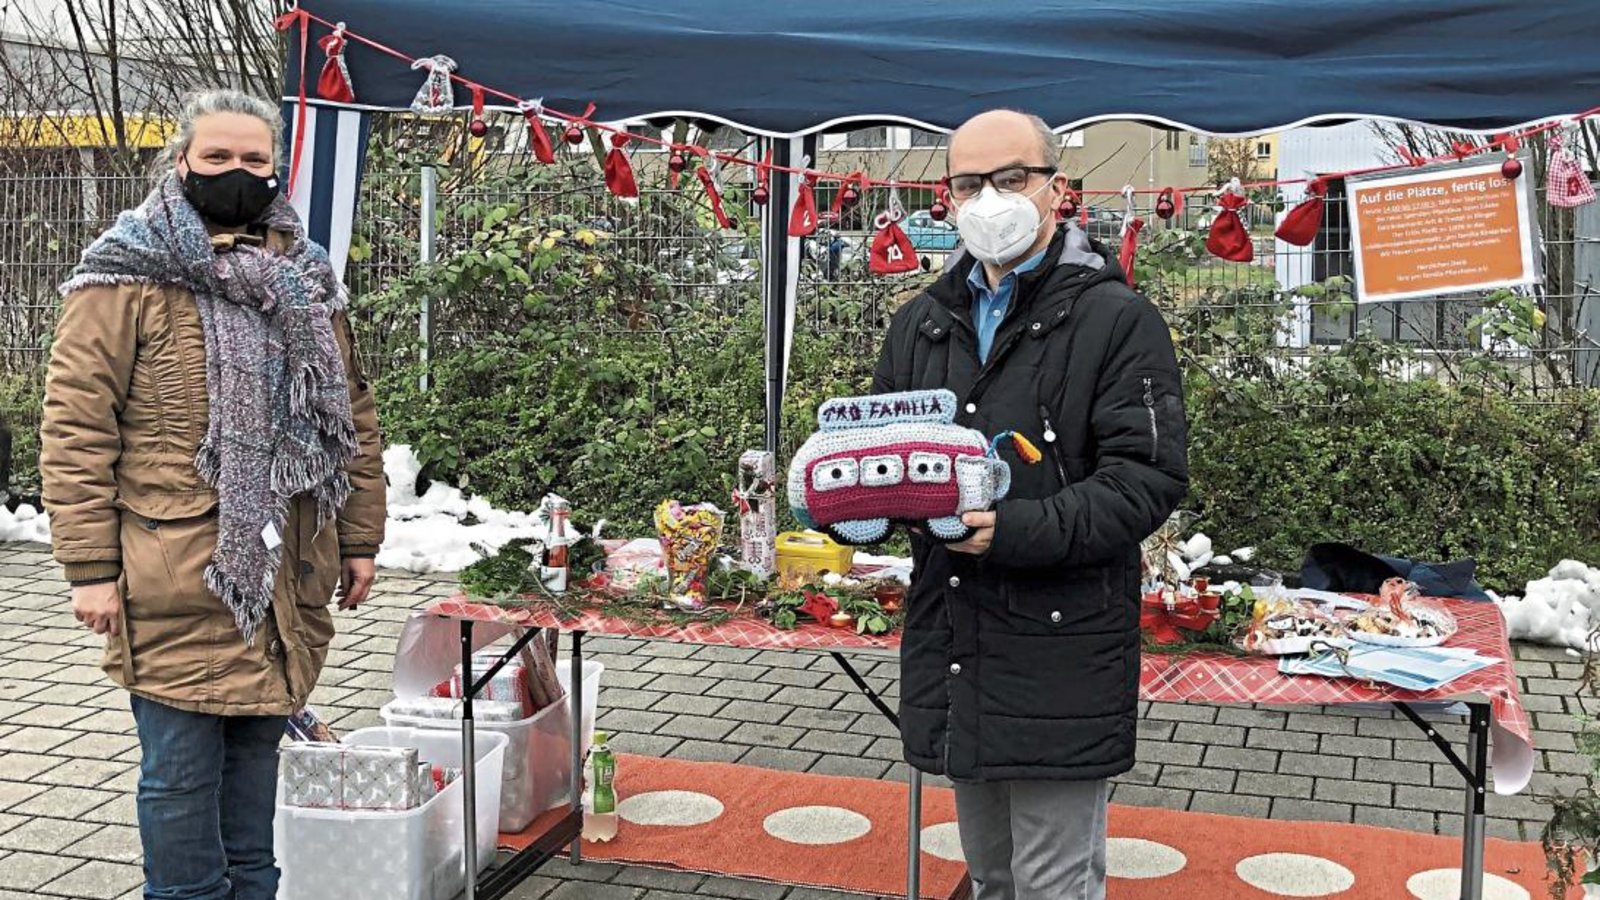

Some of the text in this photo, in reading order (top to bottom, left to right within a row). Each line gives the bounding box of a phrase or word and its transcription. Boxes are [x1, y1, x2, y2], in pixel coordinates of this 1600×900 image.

[1360, 191, 1381, 205] Auf
[1384, 189, 1404, 201] die
[1407, 185, 1449, 199] Plätze,
[1452, 179, 1487, 193] fertig
[823, 402, 861, 421] PRO
